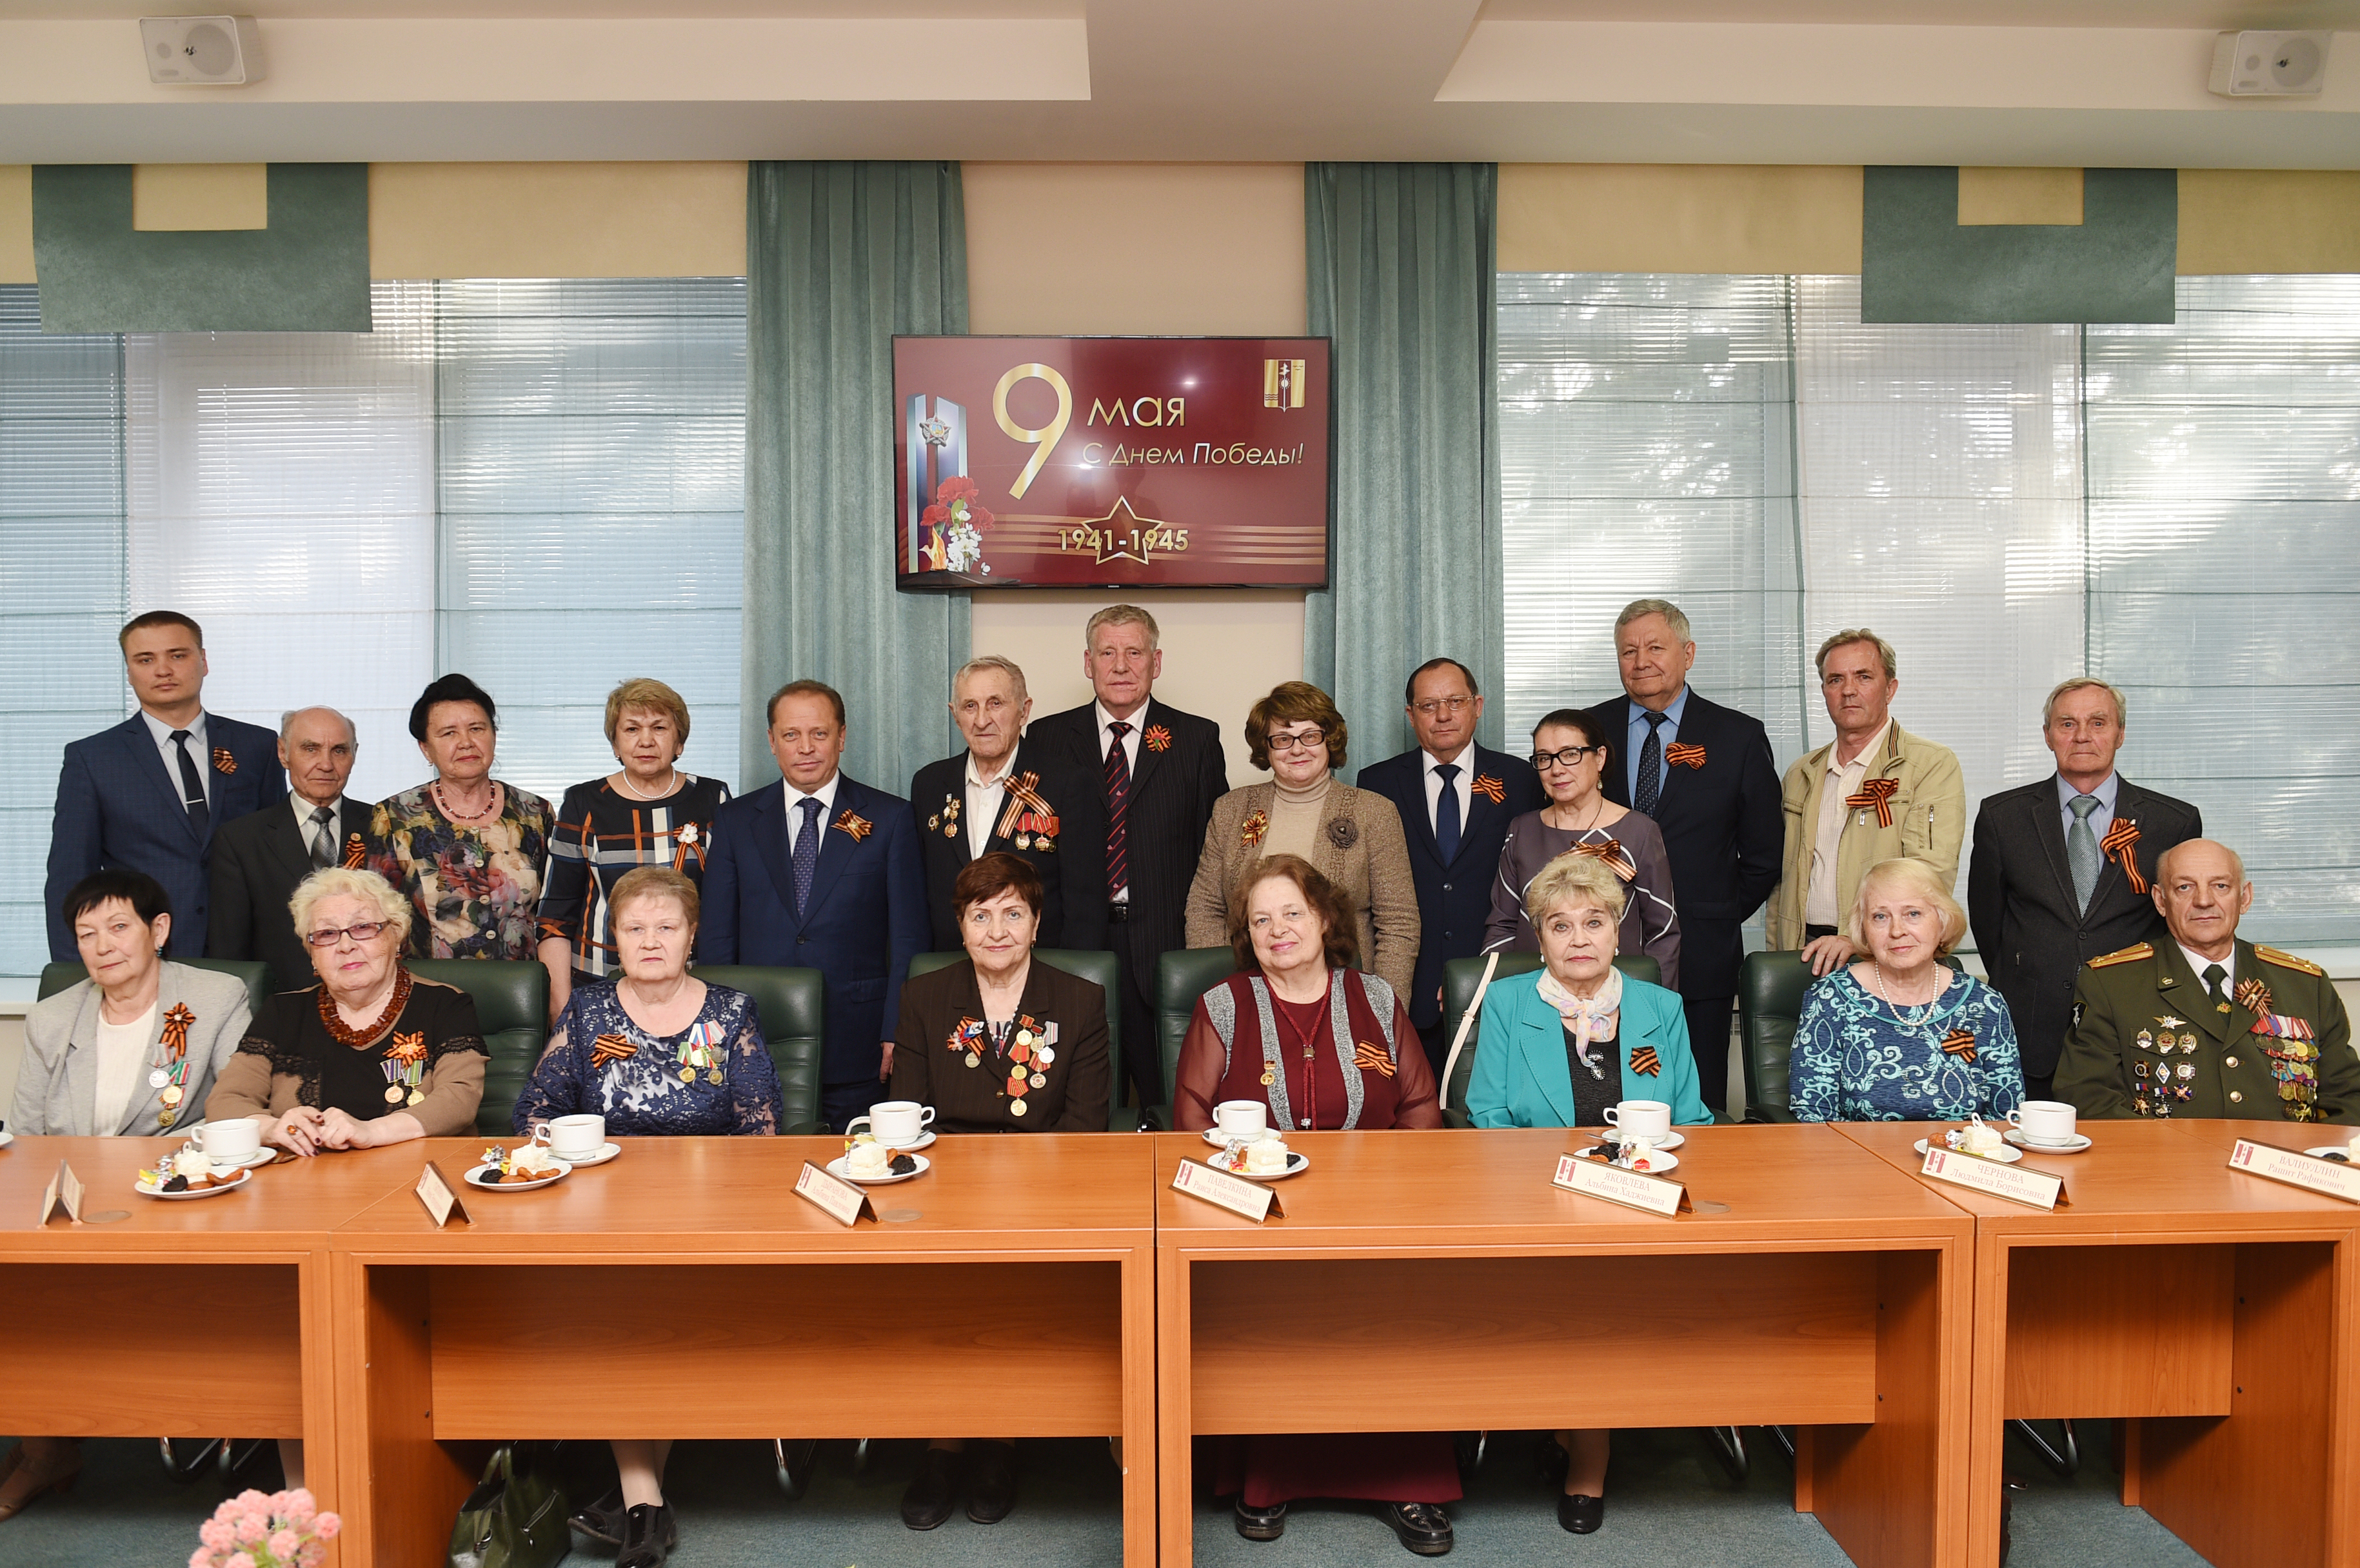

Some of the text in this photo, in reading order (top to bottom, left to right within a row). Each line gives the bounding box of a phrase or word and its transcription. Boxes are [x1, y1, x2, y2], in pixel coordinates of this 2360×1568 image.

[993, 362, 1185, 501] 9 мая
[1082, 442, 1305, 466] С Днем Победы!
[1058, 529, 1189, 551] 1941-1945
[1978, 1164, 2024, 1184] ЧЕРНОВА
[2268, 1163, 2346, 1191] Рашит Рафикович
[2279, 1155, 2341, 1179] ВАЛИУЛЛИН
[1207, 1174, 1252, 1198] ПАВЕЛКИНА
[1585, 1178, 1665, 1206] Альбина Хаджиевна
[1603, 1172, 1651, 1191] ЯКОВЛЕВА
[1950, 1168, 2046, 1200] Людмила Борисовна
[1193, 1180, 1261, 1213] Раиса Александровна
